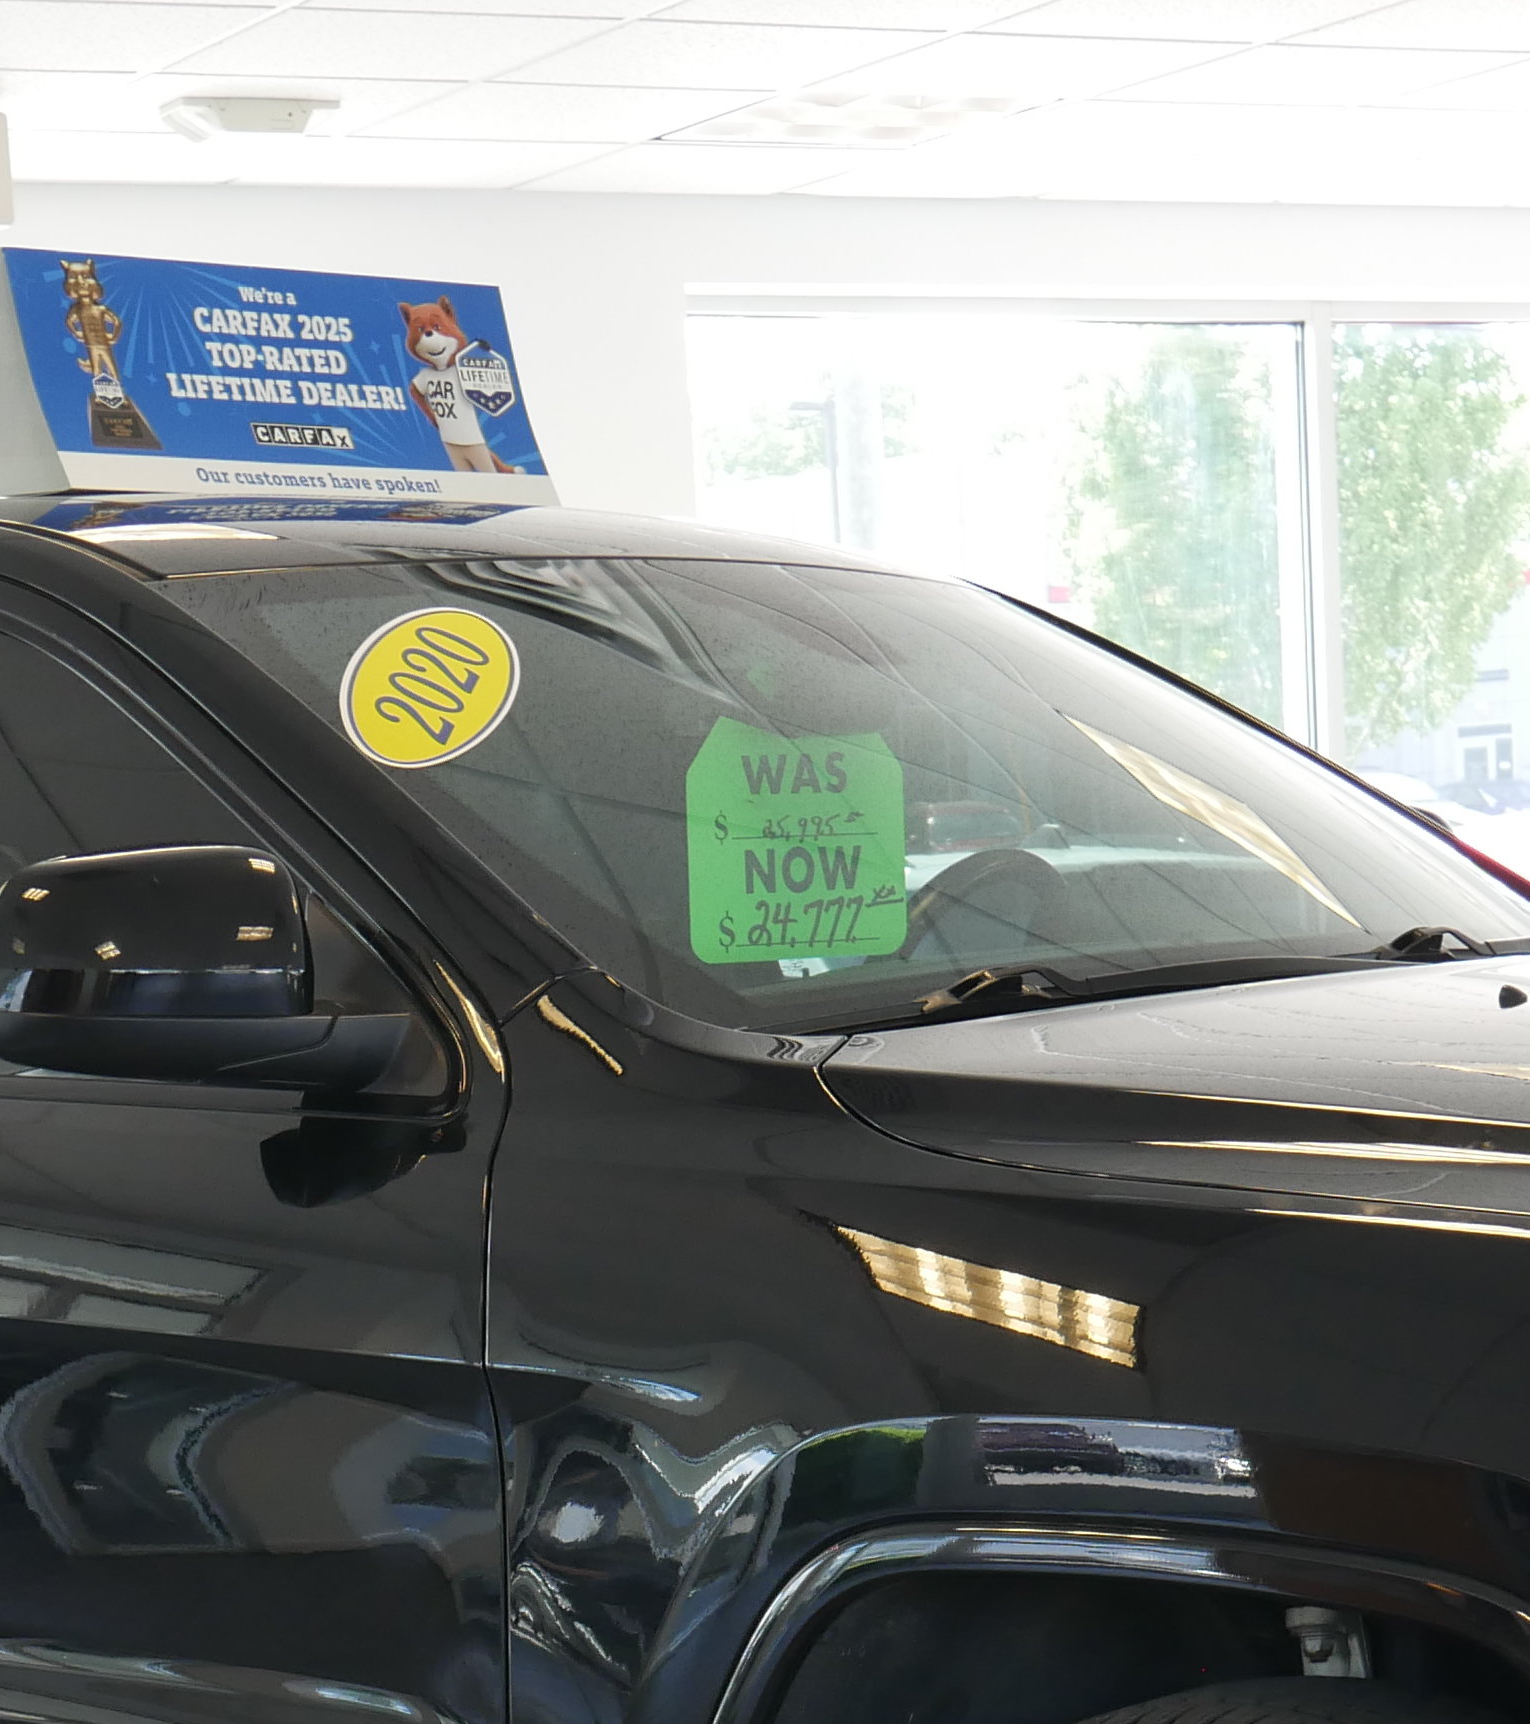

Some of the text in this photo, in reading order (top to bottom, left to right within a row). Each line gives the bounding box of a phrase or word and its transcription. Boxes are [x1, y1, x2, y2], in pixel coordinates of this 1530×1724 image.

[238, 286, 297, 306] We're a
[193, 306, 354, 343] CARFAX 2025
[205, 341, 348, 375] TOP-RATED
[165, 372, 297, 405] LIFETIME
[298, 380, 407, 411] DEALER!
[427, 381, 455, 400] CAR
[460, 369, 508, 384] LIFETIME
[253, 423, 352, 449] CARFAX
[196, 466, 442, 496] Our customers have spoken!
[375, 627, 489, 745] 2020
[741, 751, 847, 795] WAS
[714, 810, 728, 845] $
[744, 845, 861, 894] NOW
[719, 910, 735, 953] $
